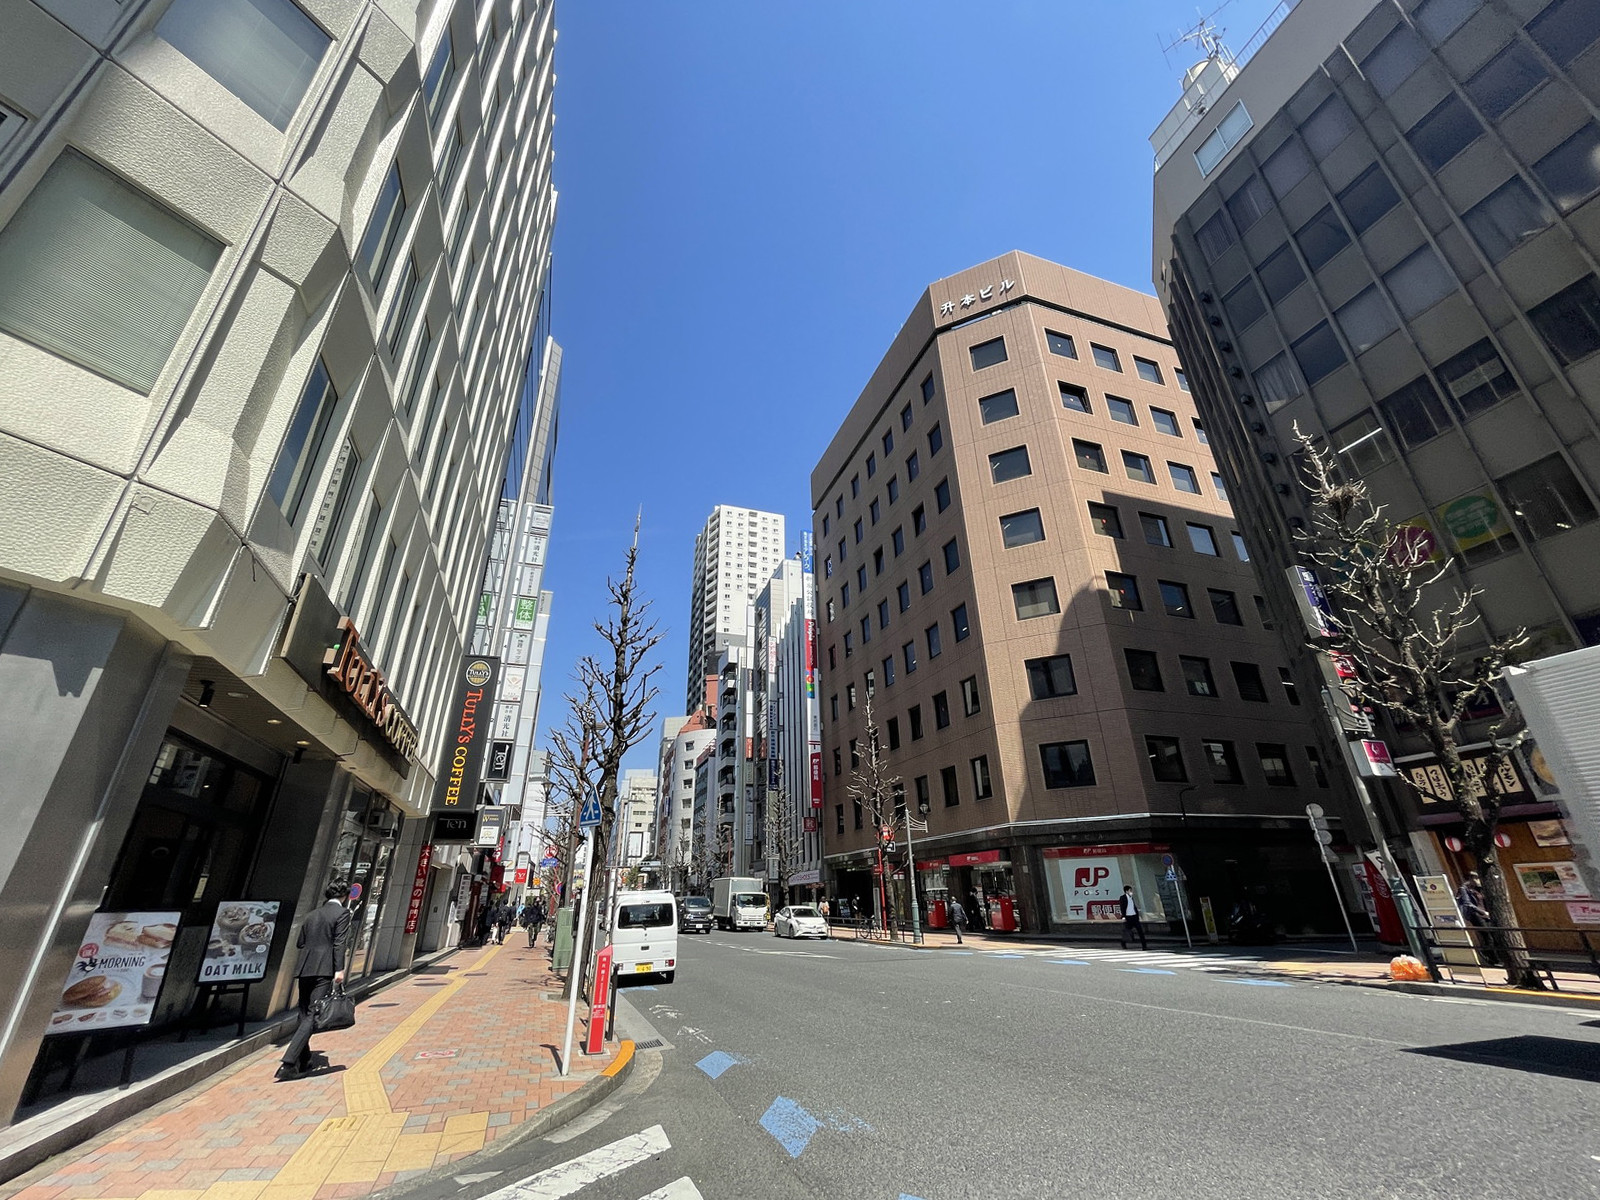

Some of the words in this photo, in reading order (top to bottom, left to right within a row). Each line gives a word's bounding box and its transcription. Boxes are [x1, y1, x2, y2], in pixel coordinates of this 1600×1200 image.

[940, 279, 1015, 315] 升本ビル
[518, 598, 534, 620] 整体
[323, 615, 389, 727] TULLY'S
[457, 688, 483, 744] TULLY'S
[445, 746, 468, 806] COFFEE
[1075, 866, 1110, 888] JP
[98, 956, 146, 969] MORNING
[204, 964, 228, 977] OAT
[232, 962, 263, 975] MILK
